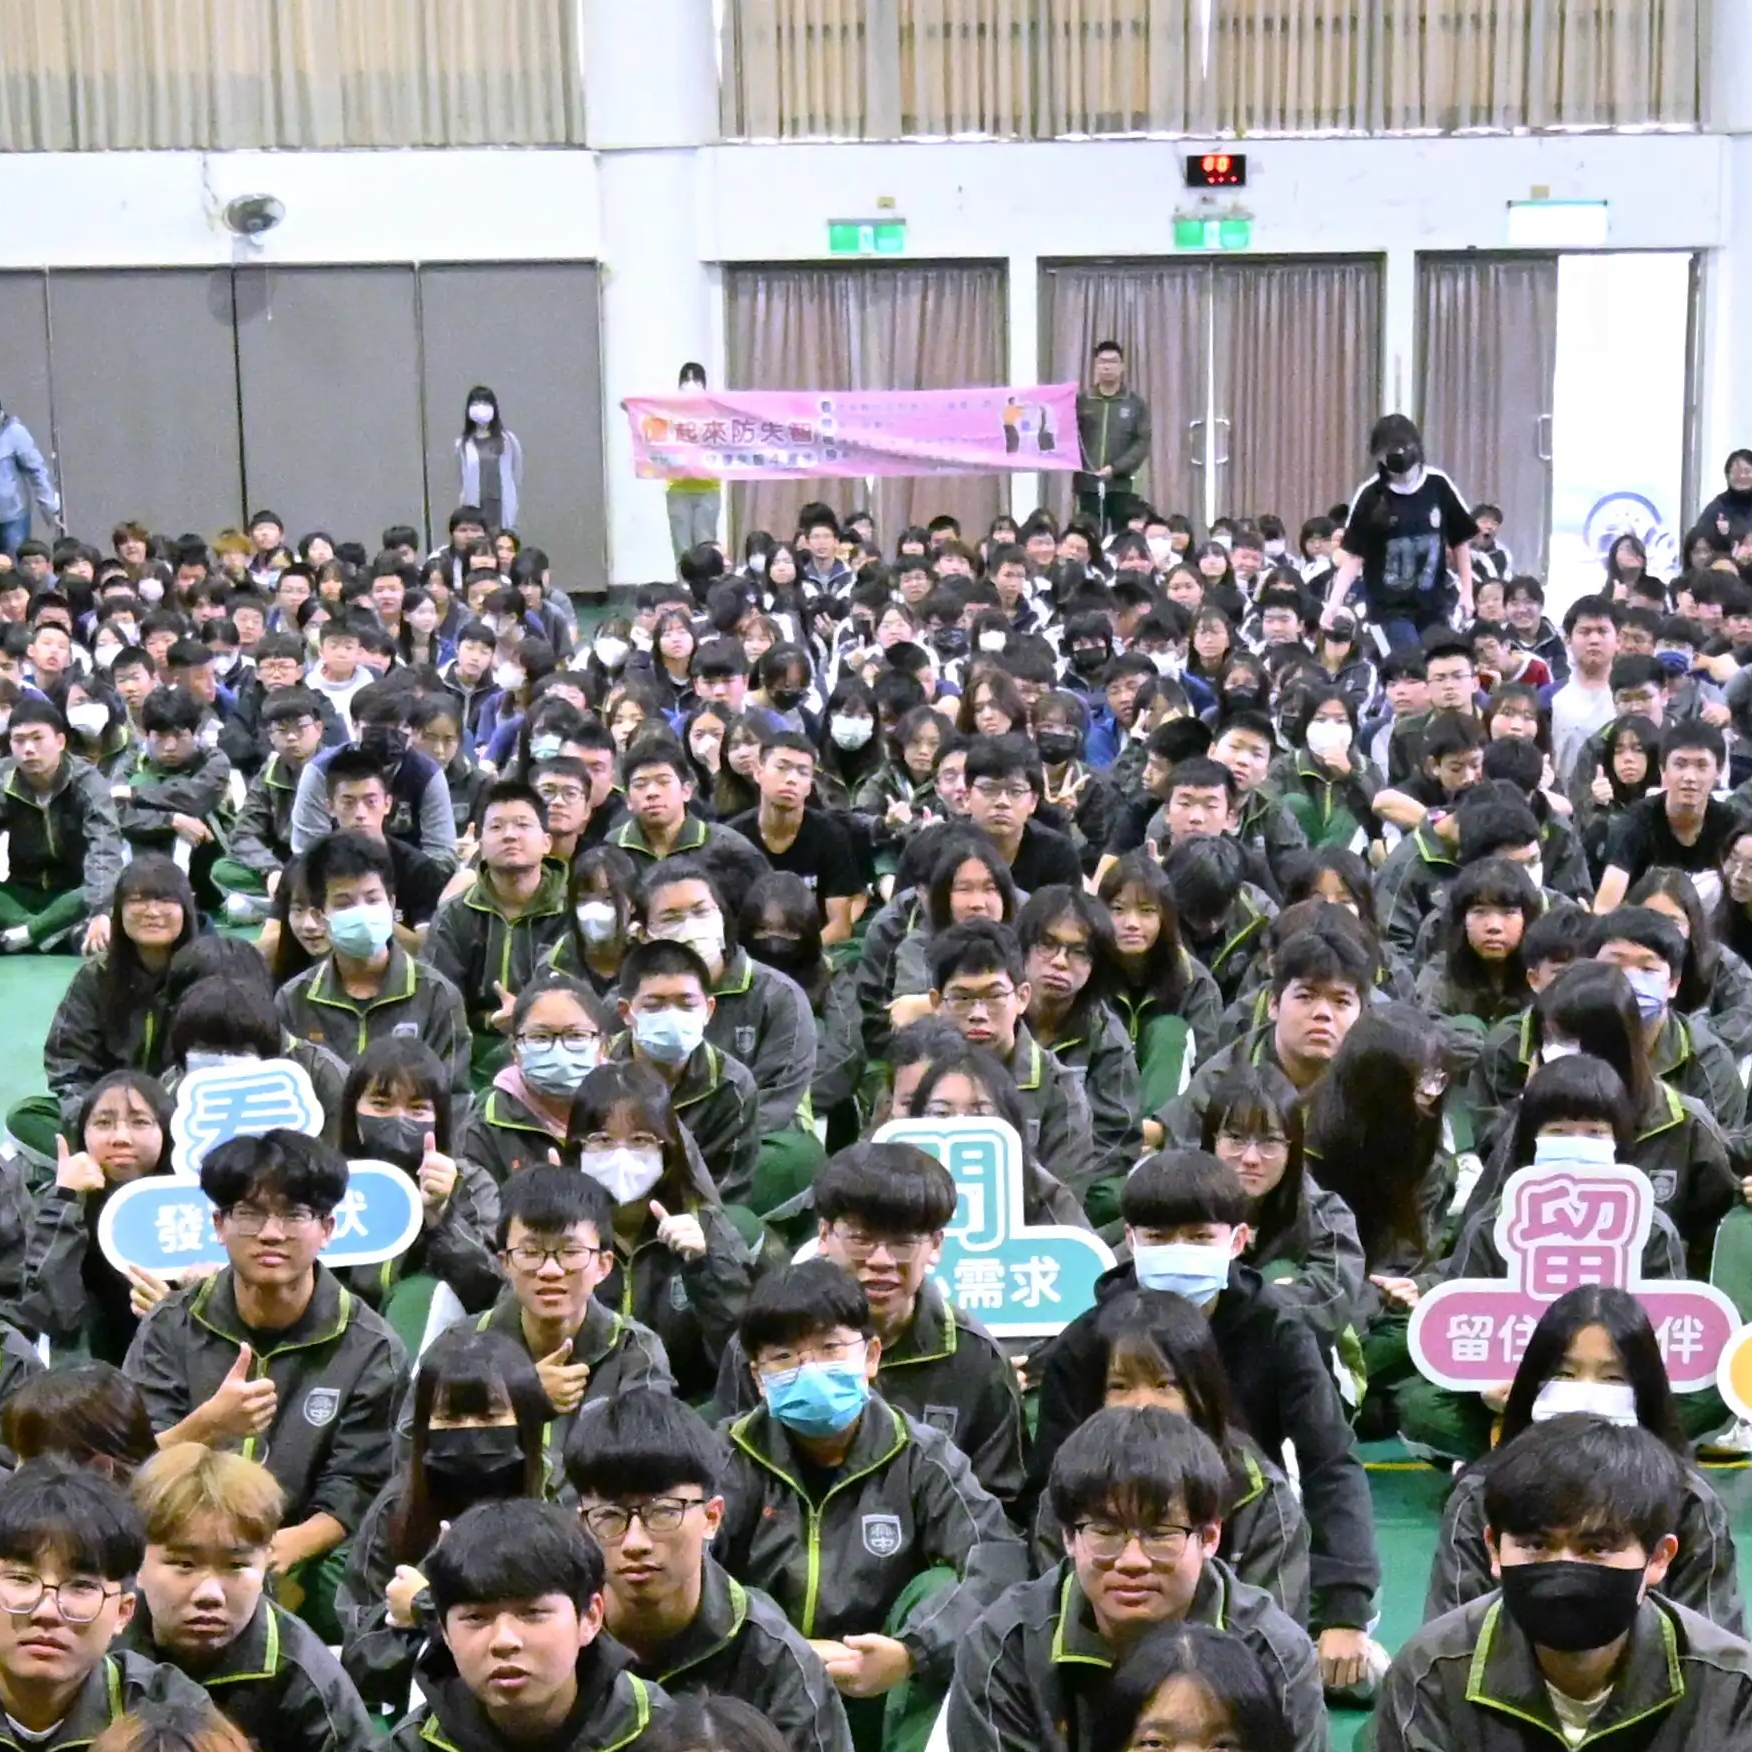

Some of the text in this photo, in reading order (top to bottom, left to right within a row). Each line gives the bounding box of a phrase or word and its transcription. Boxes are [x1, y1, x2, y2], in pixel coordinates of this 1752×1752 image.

[1519, 1184, 1630, 1298] 留
[1446, 1313, 1705, 1365] 留住伴
